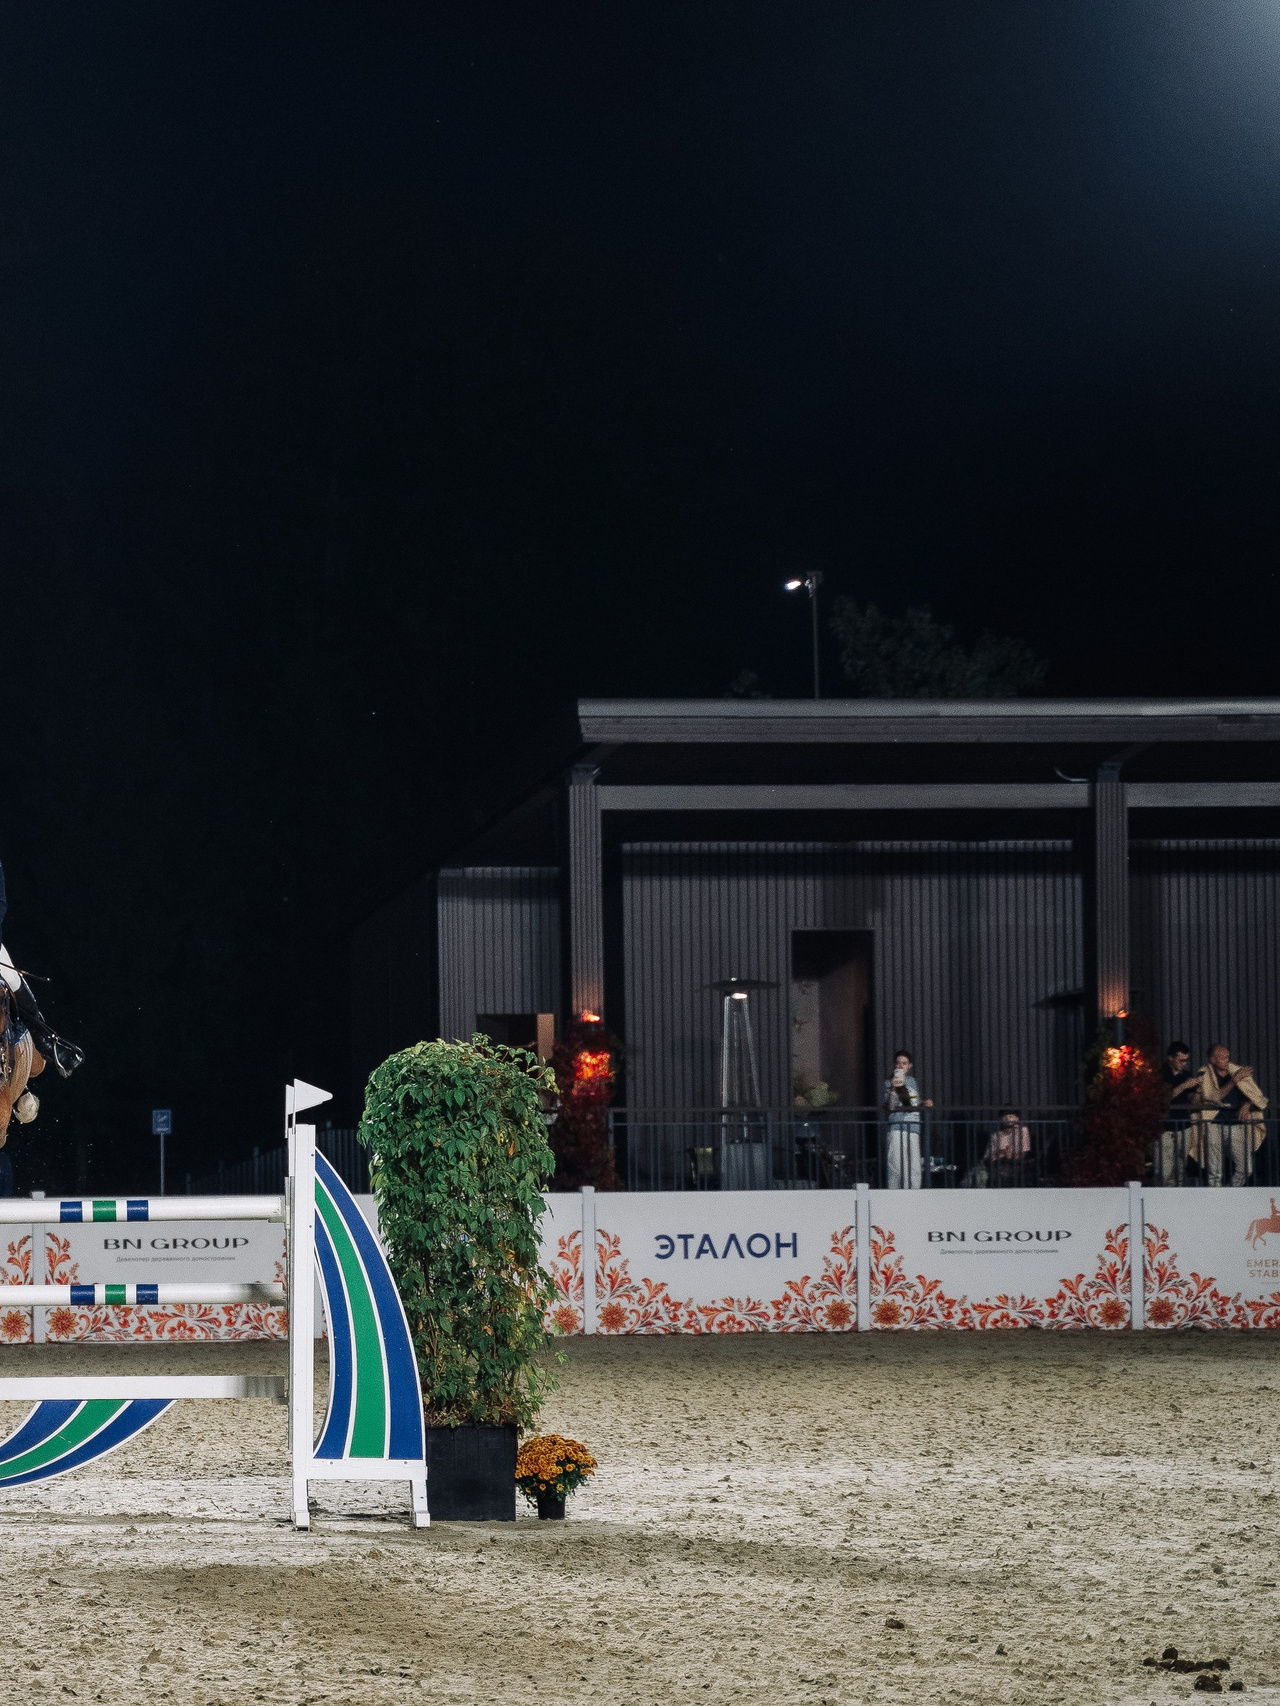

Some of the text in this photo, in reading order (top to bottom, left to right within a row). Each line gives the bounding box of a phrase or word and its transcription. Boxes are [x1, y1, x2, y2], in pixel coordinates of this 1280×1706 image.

[927, 1230, 1072, 1242] BN GROUP
[103, 1237, 249, 1250] BN GROUP
[654, 1232, 798, 1260] ЭТАЛОН
[1246, 1259, 1280, 1268] EMER
[1249, 1269, 1280, 1278] STAB
